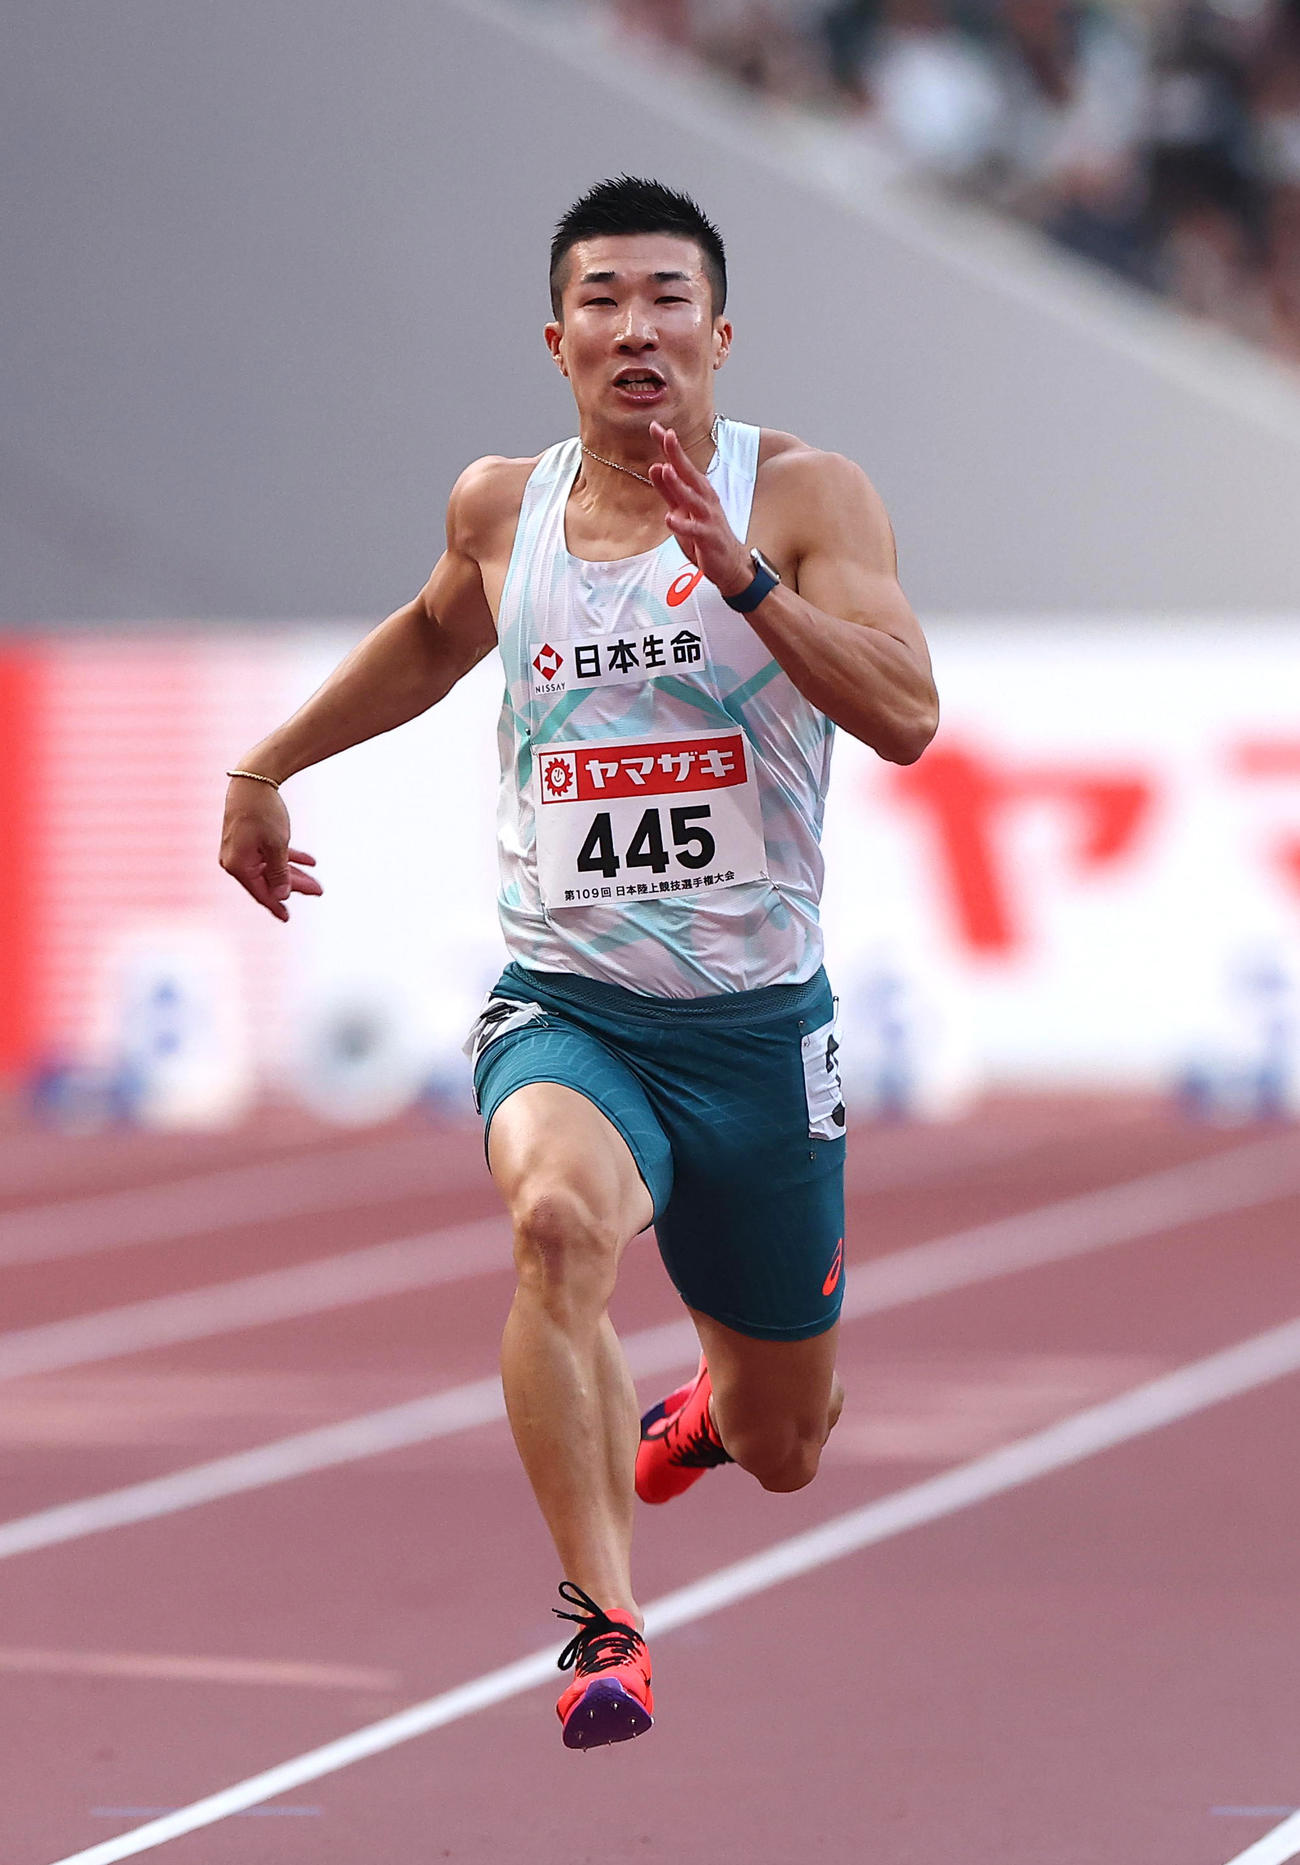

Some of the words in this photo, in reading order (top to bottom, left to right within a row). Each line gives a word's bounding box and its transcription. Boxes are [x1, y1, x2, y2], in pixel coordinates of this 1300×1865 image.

[574, 630, 702, 679] 日本生命
[535, 682, 566, 694] NISSAY
[585, 749, 736, 789] ヤマザキ
[576, 803, 716, 879] 445
[564, 886, 612, 902] 第109回
